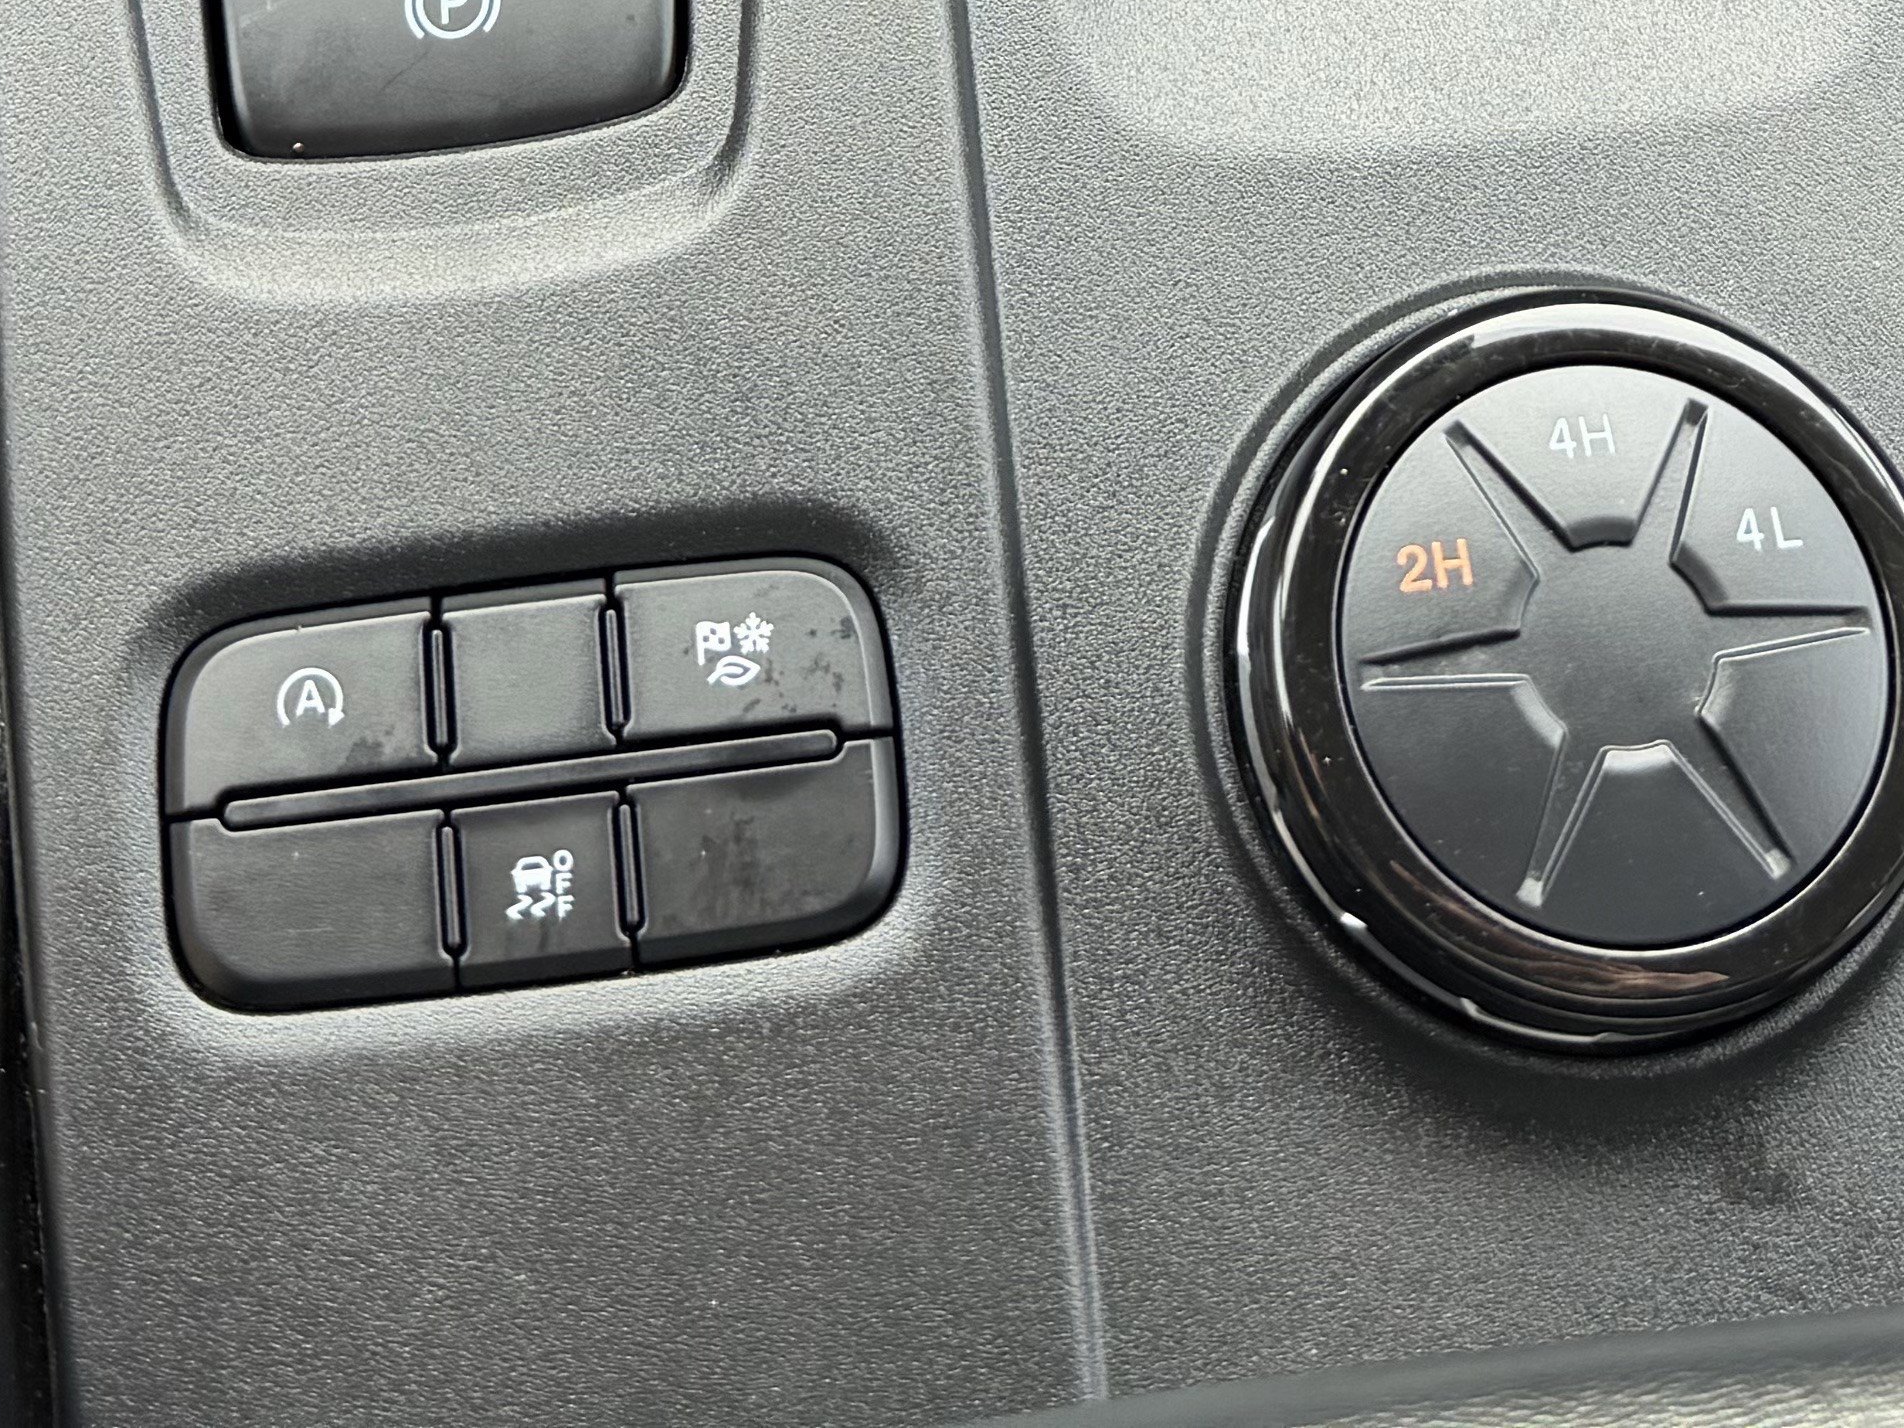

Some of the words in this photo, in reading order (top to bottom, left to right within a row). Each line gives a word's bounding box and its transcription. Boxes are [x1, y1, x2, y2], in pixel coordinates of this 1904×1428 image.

[1547, 413, 1617, 459] 4H
[1734, 506, 1805, 553] 4L
[1397, 539, 1474, 593] 2H
[294, 678, 327, 719] A
